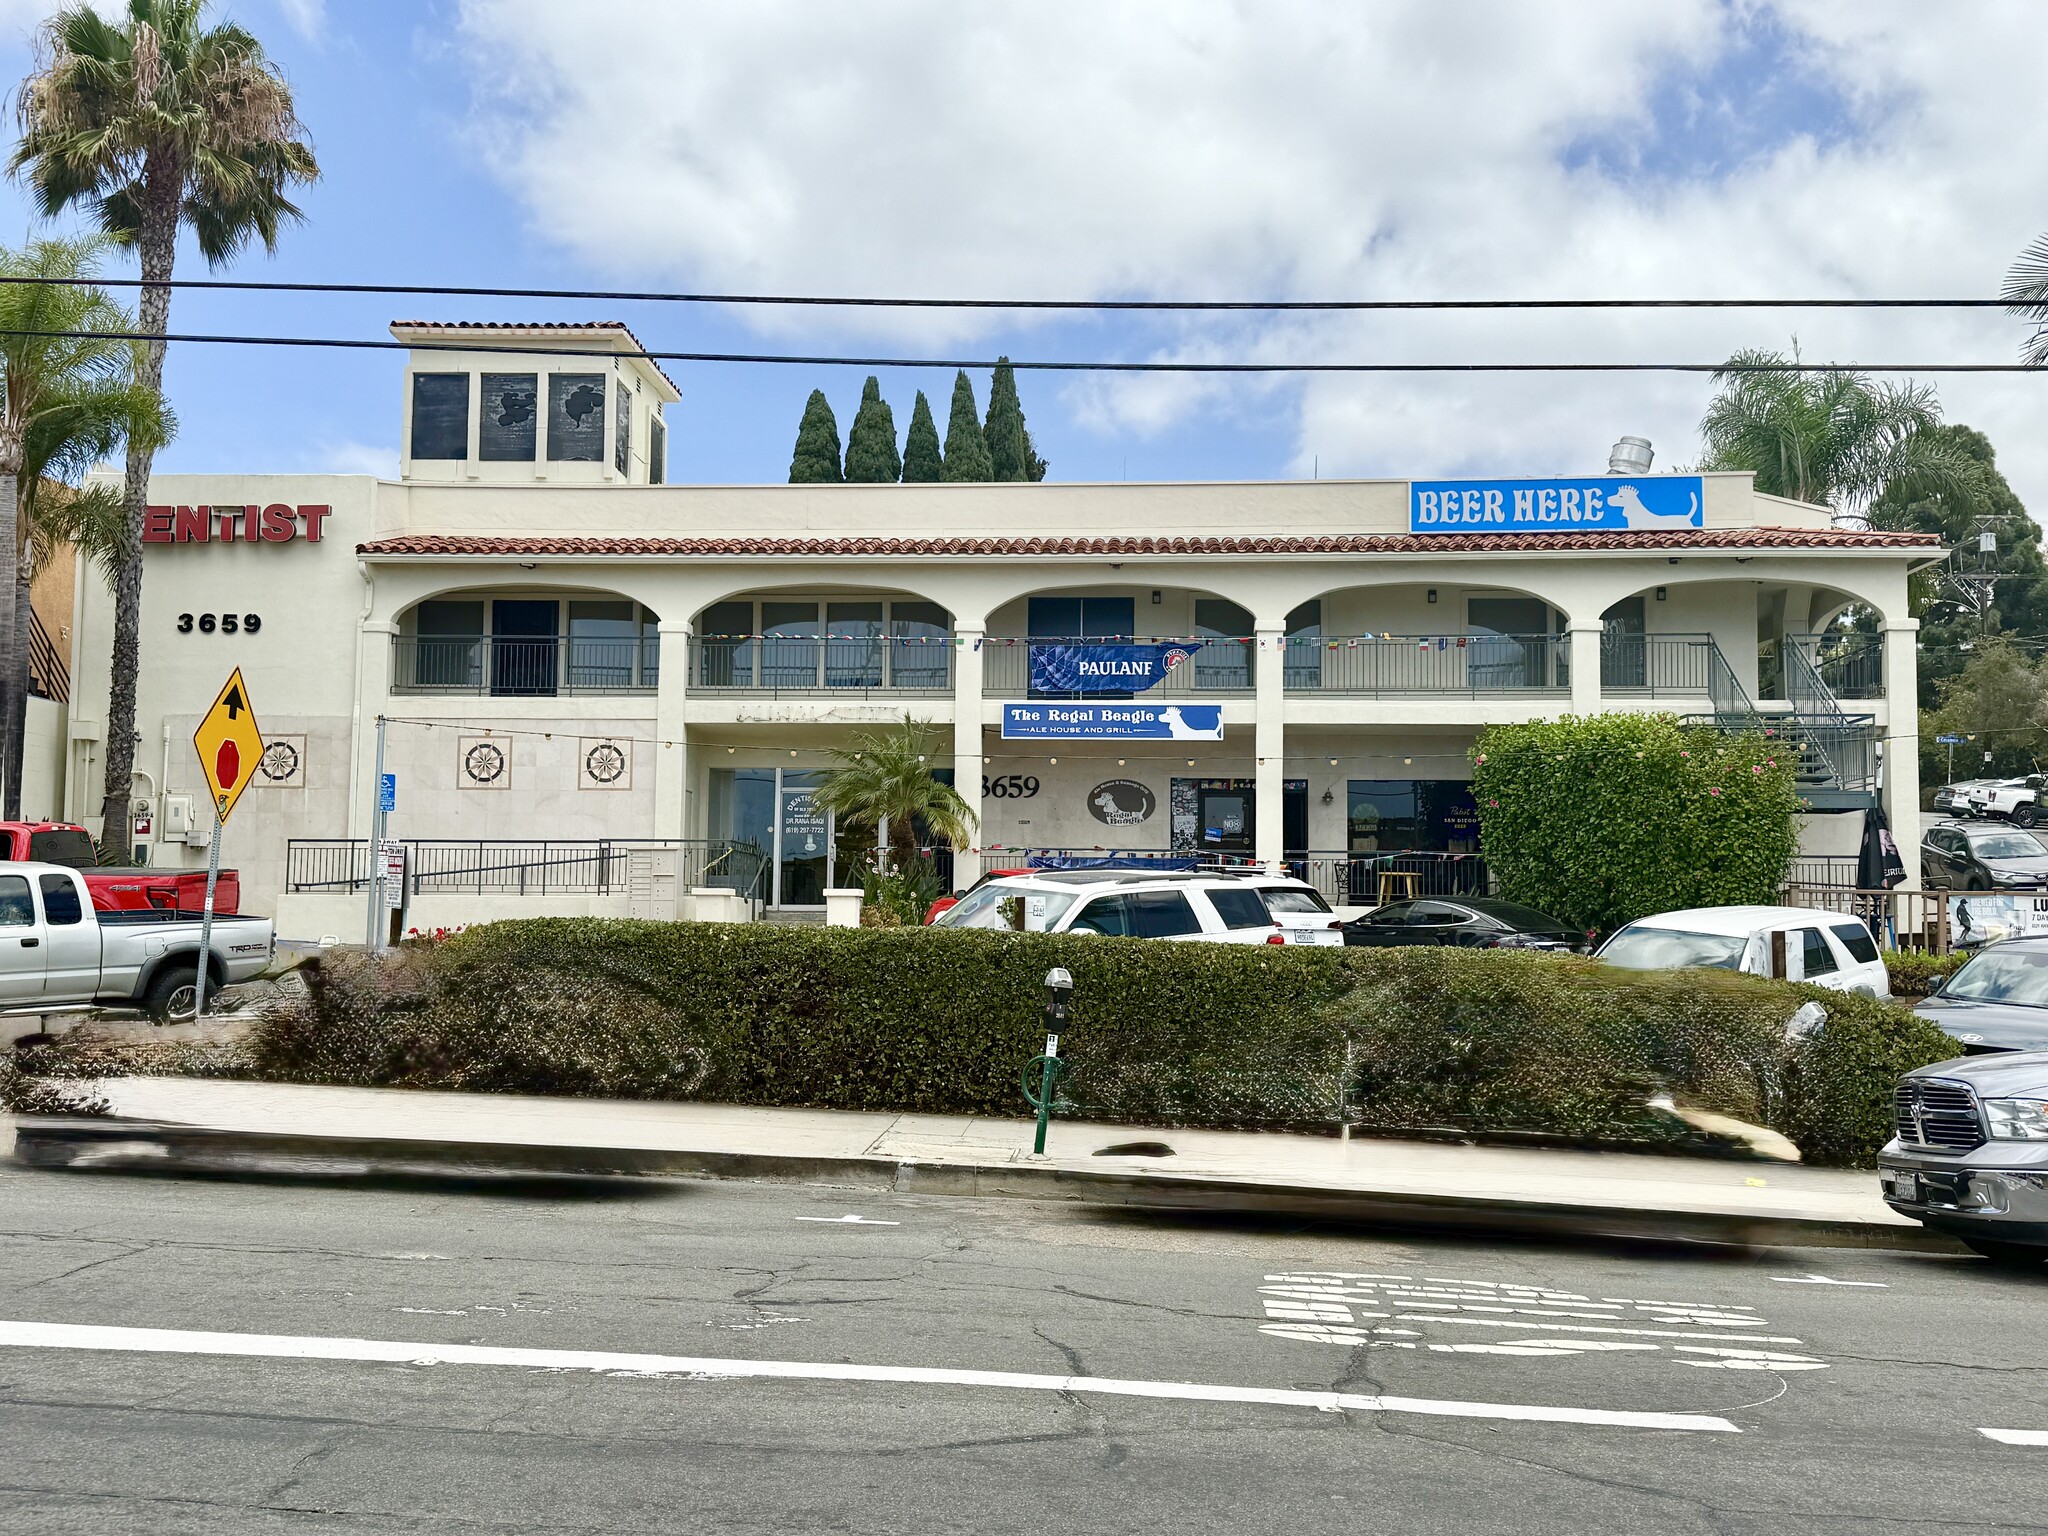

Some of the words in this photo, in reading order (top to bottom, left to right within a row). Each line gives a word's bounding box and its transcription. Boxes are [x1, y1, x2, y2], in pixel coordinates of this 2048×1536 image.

[1418, 489, 1505, 523] BEER
[1513, 487, 1604, 522] HERE
[142, 503, 332, 543] ENTIST
[177, 613, 262, 633] 3659
[1011, 709, 1040, 721] The
[1048, 709, 1093, 725] Regal
[1101, 710, 1155, 725] Beagle
[1106, 726, 1133, 734] GRILL
[787, 795, 821, 811] DENTISTR
[1970, 897, 1993, 907] BREWED
[2033, 898, 2048, 912] LU
[1972, 907, 1982, 916] THE
